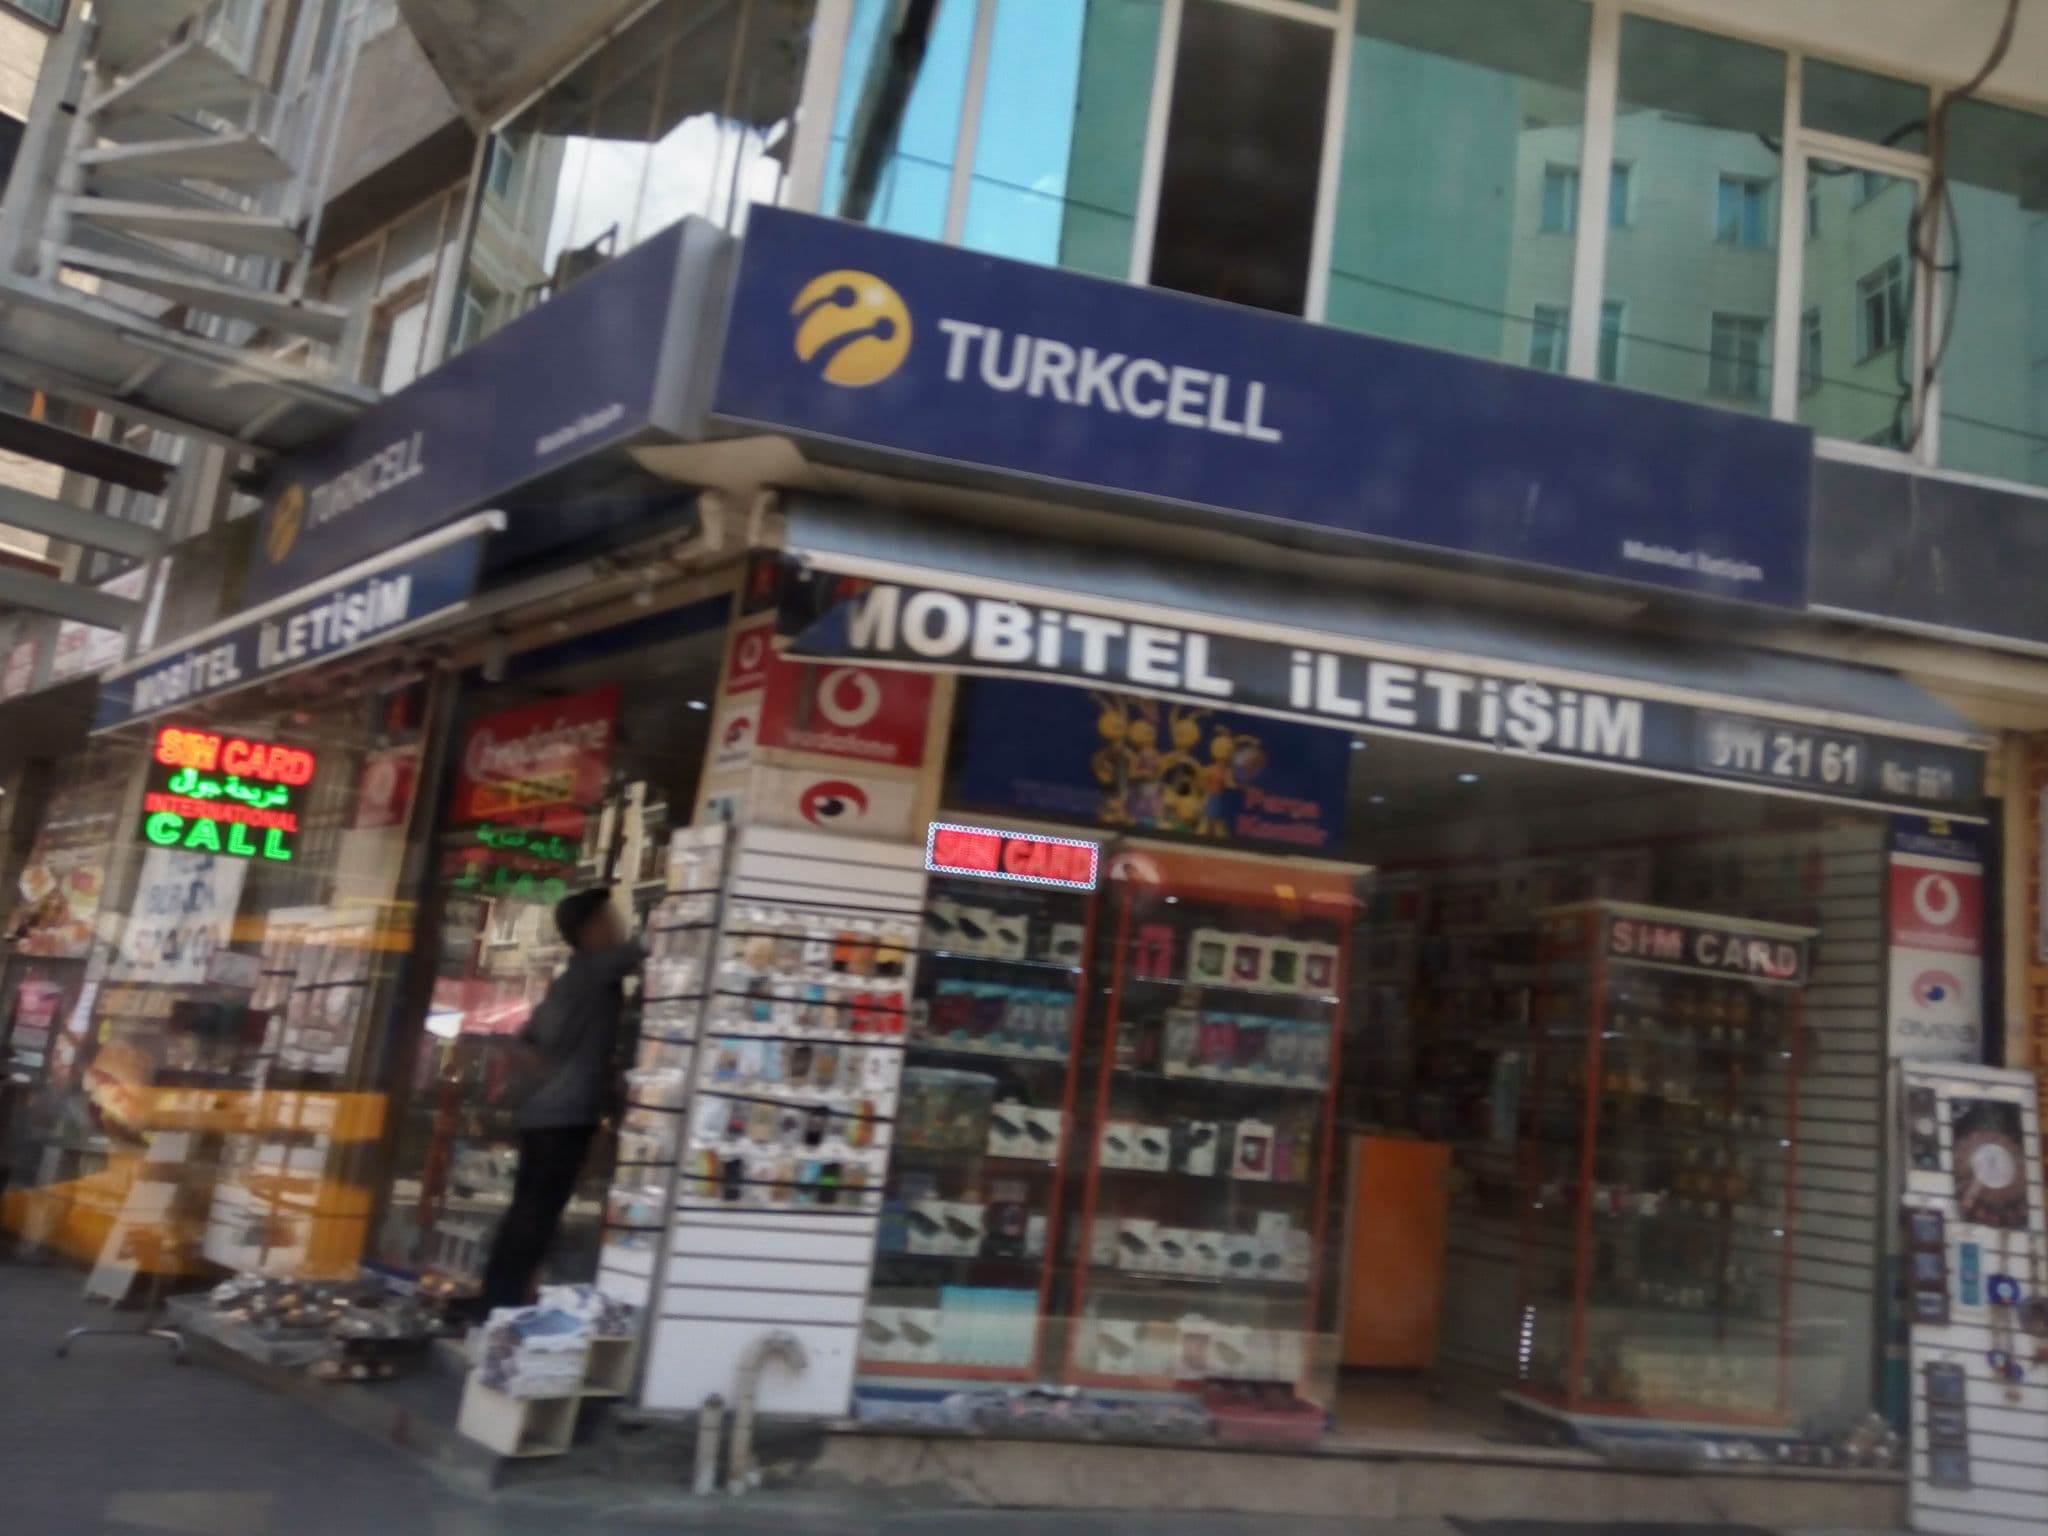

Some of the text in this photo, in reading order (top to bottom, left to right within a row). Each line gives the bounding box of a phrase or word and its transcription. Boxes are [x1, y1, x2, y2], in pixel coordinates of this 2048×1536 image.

[938, 317, 1283, 443] TURKCELL
[220, 738, 315, 786] CARD
[1771, 735, 1814, 778] 21
[1820, 741, 1858, 785] 61
[144, 791, 298, 833] INTERNATIONAL
[145, 811, 292, 862] CALL
[1612, 918, 1798, 978] SIM CARD
